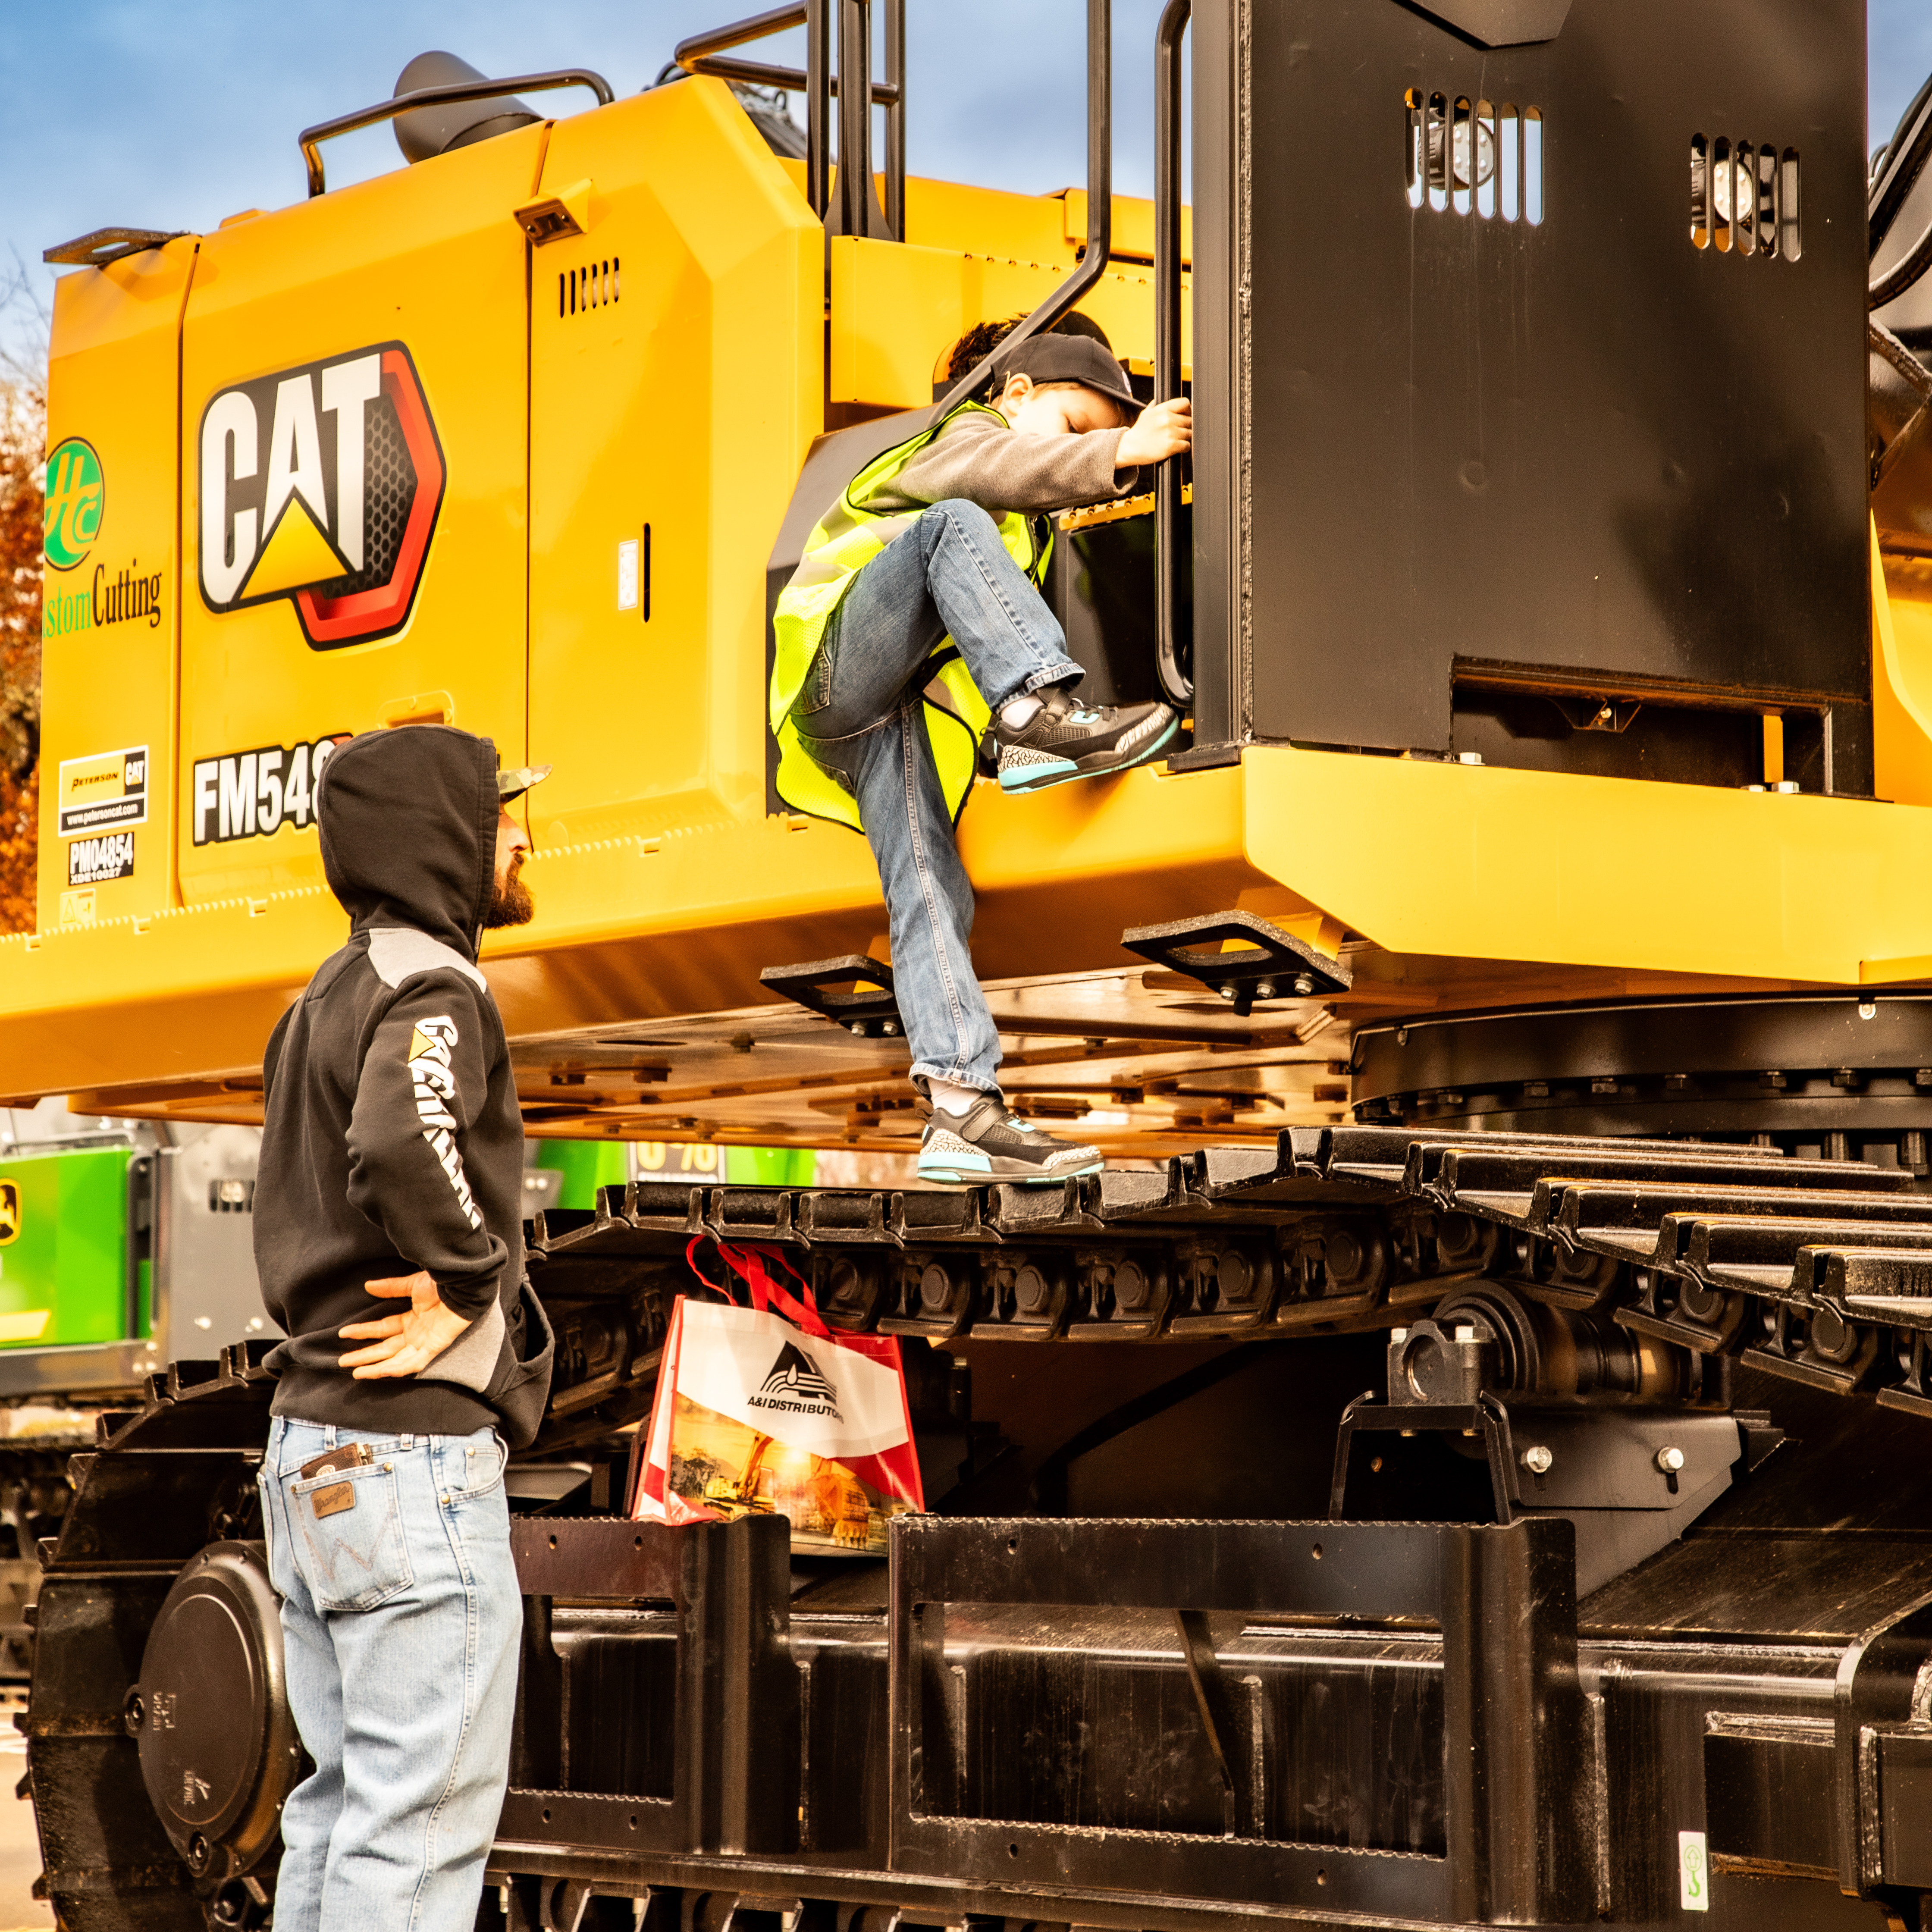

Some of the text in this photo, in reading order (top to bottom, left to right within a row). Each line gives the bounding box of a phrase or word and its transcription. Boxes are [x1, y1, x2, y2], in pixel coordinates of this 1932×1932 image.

[202, 353, 380, 604] CAT
[72, 760, 144, 792] PETERSON CAT
[67, 803, 138, 825] www.petersoncat.com
[70, 832, 133, 874] PM04854
[70, 867, 122, 885] XDE10027
[747, 1396, 844, 1424] A&I DISTRIBUTO
